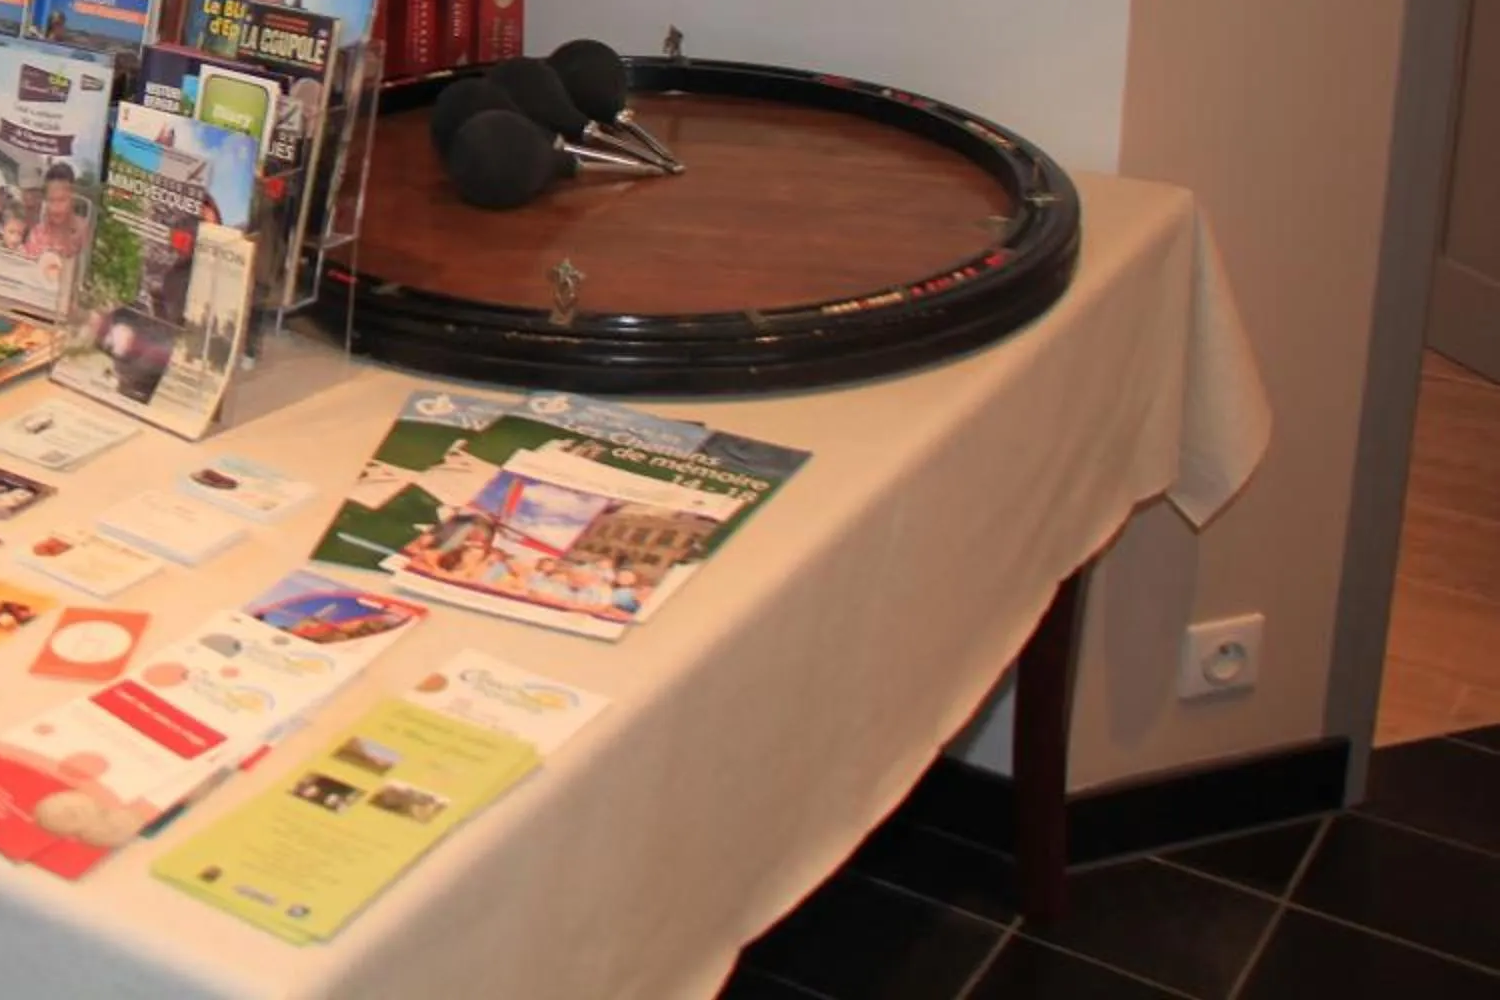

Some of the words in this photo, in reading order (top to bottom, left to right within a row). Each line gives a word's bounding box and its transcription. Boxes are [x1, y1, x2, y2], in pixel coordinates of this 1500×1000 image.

[240, 23, 259, 51] LA
[260, 28, 327, 66] COUPOLE
[610, 430, 722, 467] Chemins
[611, 447, 648, 463] de
[650, 456, 771, 491] mémoire
